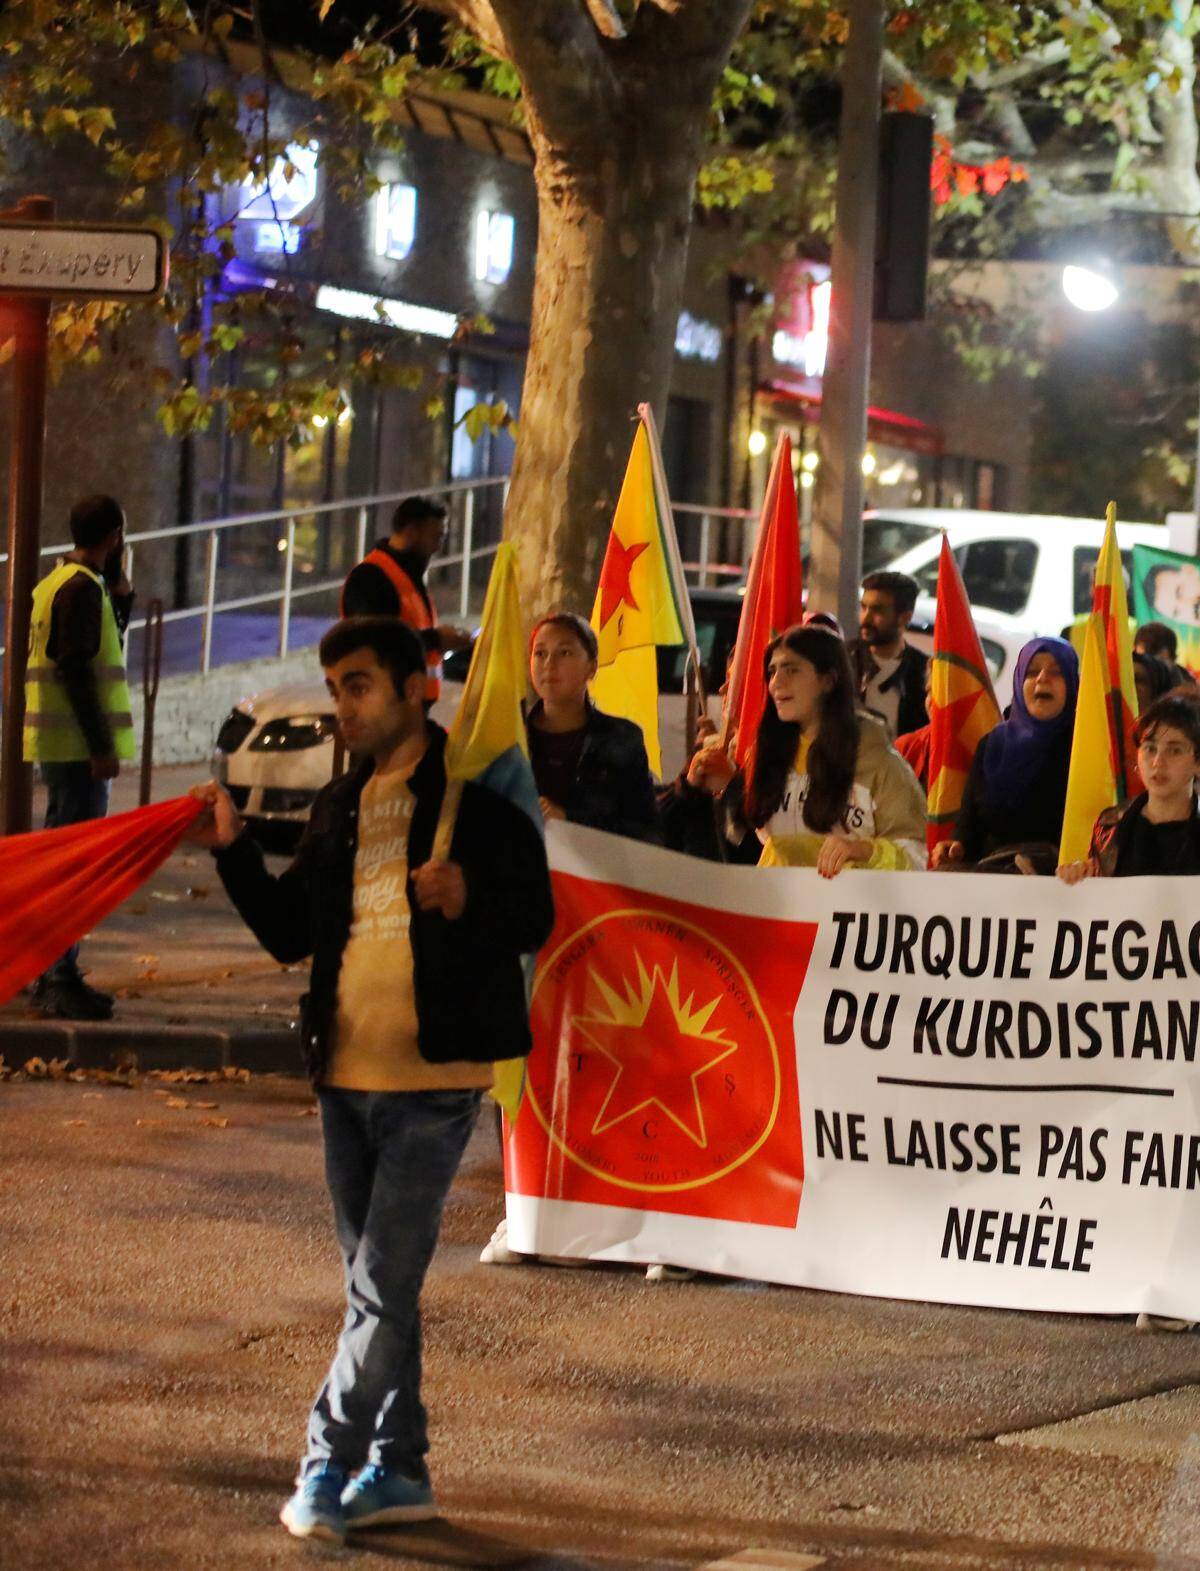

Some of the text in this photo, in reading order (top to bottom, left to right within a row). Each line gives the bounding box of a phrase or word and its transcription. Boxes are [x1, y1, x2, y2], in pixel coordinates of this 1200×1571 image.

[829, 911, 1037, 980] TURQUIE
[823, 988, 901, 1050] DU
[913, 996, 1200, 1062] KURDISTAN
[641, 1120, 659, 1139] C
[814, 1109, 869, 1162] NE
[883, 1116, 1021, 1175] LAISSE
[1037, 1124, 1109, 1182] PAS
[940, 1197, 1098, 1273] NEHÊLE
